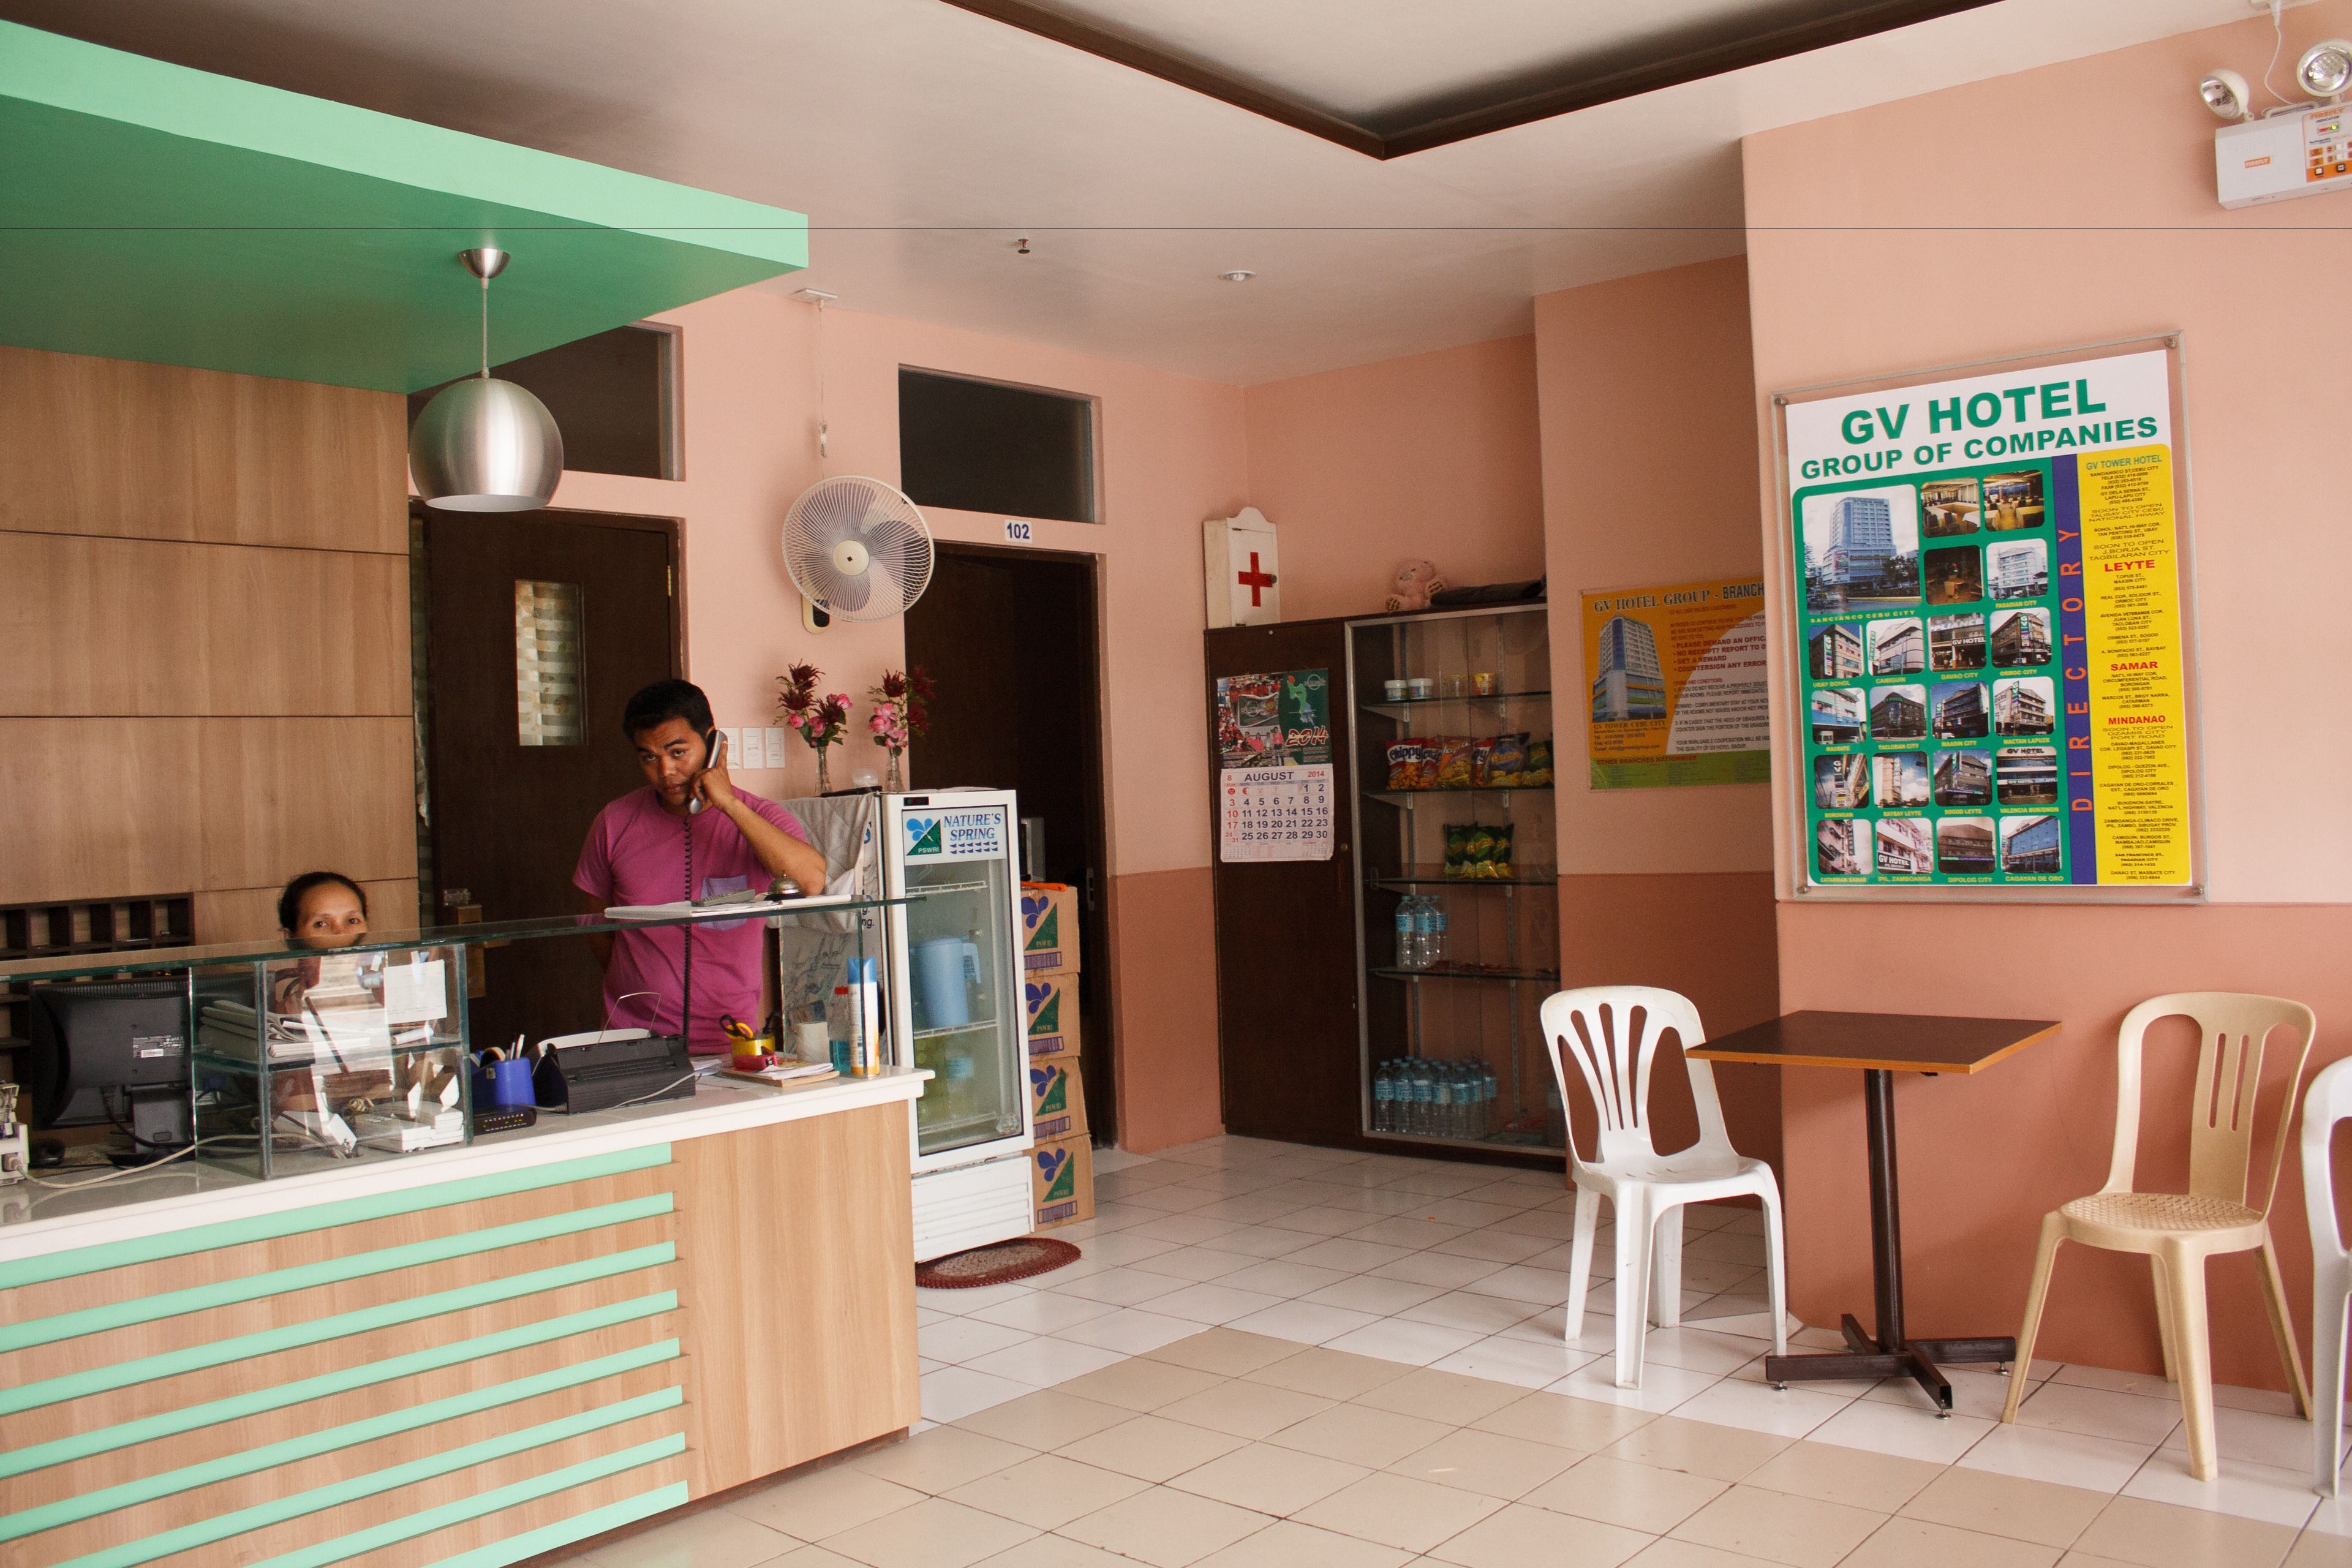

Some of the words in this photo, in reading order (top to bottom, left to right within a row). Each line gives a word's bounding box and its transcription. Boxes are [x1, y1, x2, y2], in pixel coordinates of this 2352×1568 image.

[1841, 404, 1910, 445] GV
[1928, 379, 2107, 434] HOTEL
[1801, 449, 1902, 480] GROUP
[1914, 442, 1952, 466] OF
[1964, 417, 2158, 459] COMPANIES
[2101, 458, 2132, 469] TOWER
[2133, 454, 2162, 465] HOTEL
[1007, 522, 1030, 539] 102
[2089, 552, 2146, 561] TAGBILARAN
[2105, 559, 2155, 572] LEYTE
[1594, 600, 1613, 612] GV
[1616, 595, 1660, 611] HOTEL
[1663, 590, 1711, 605] GROUP
[2057, 529, 2094, 812] DIRECTORY
[2111, 662, 2158, 671] SAMAR
[2108, 715, 2166, 725] MINDANAO
[1285, 725, 1329, 747] 2014
[1245, 772, 1294, 782] AUGUST
[944, 813, 1001, 827] NATURE'S
[950, 827, 995, 841] SPRING
[1889, 857, 1910, 865] HOTEL
